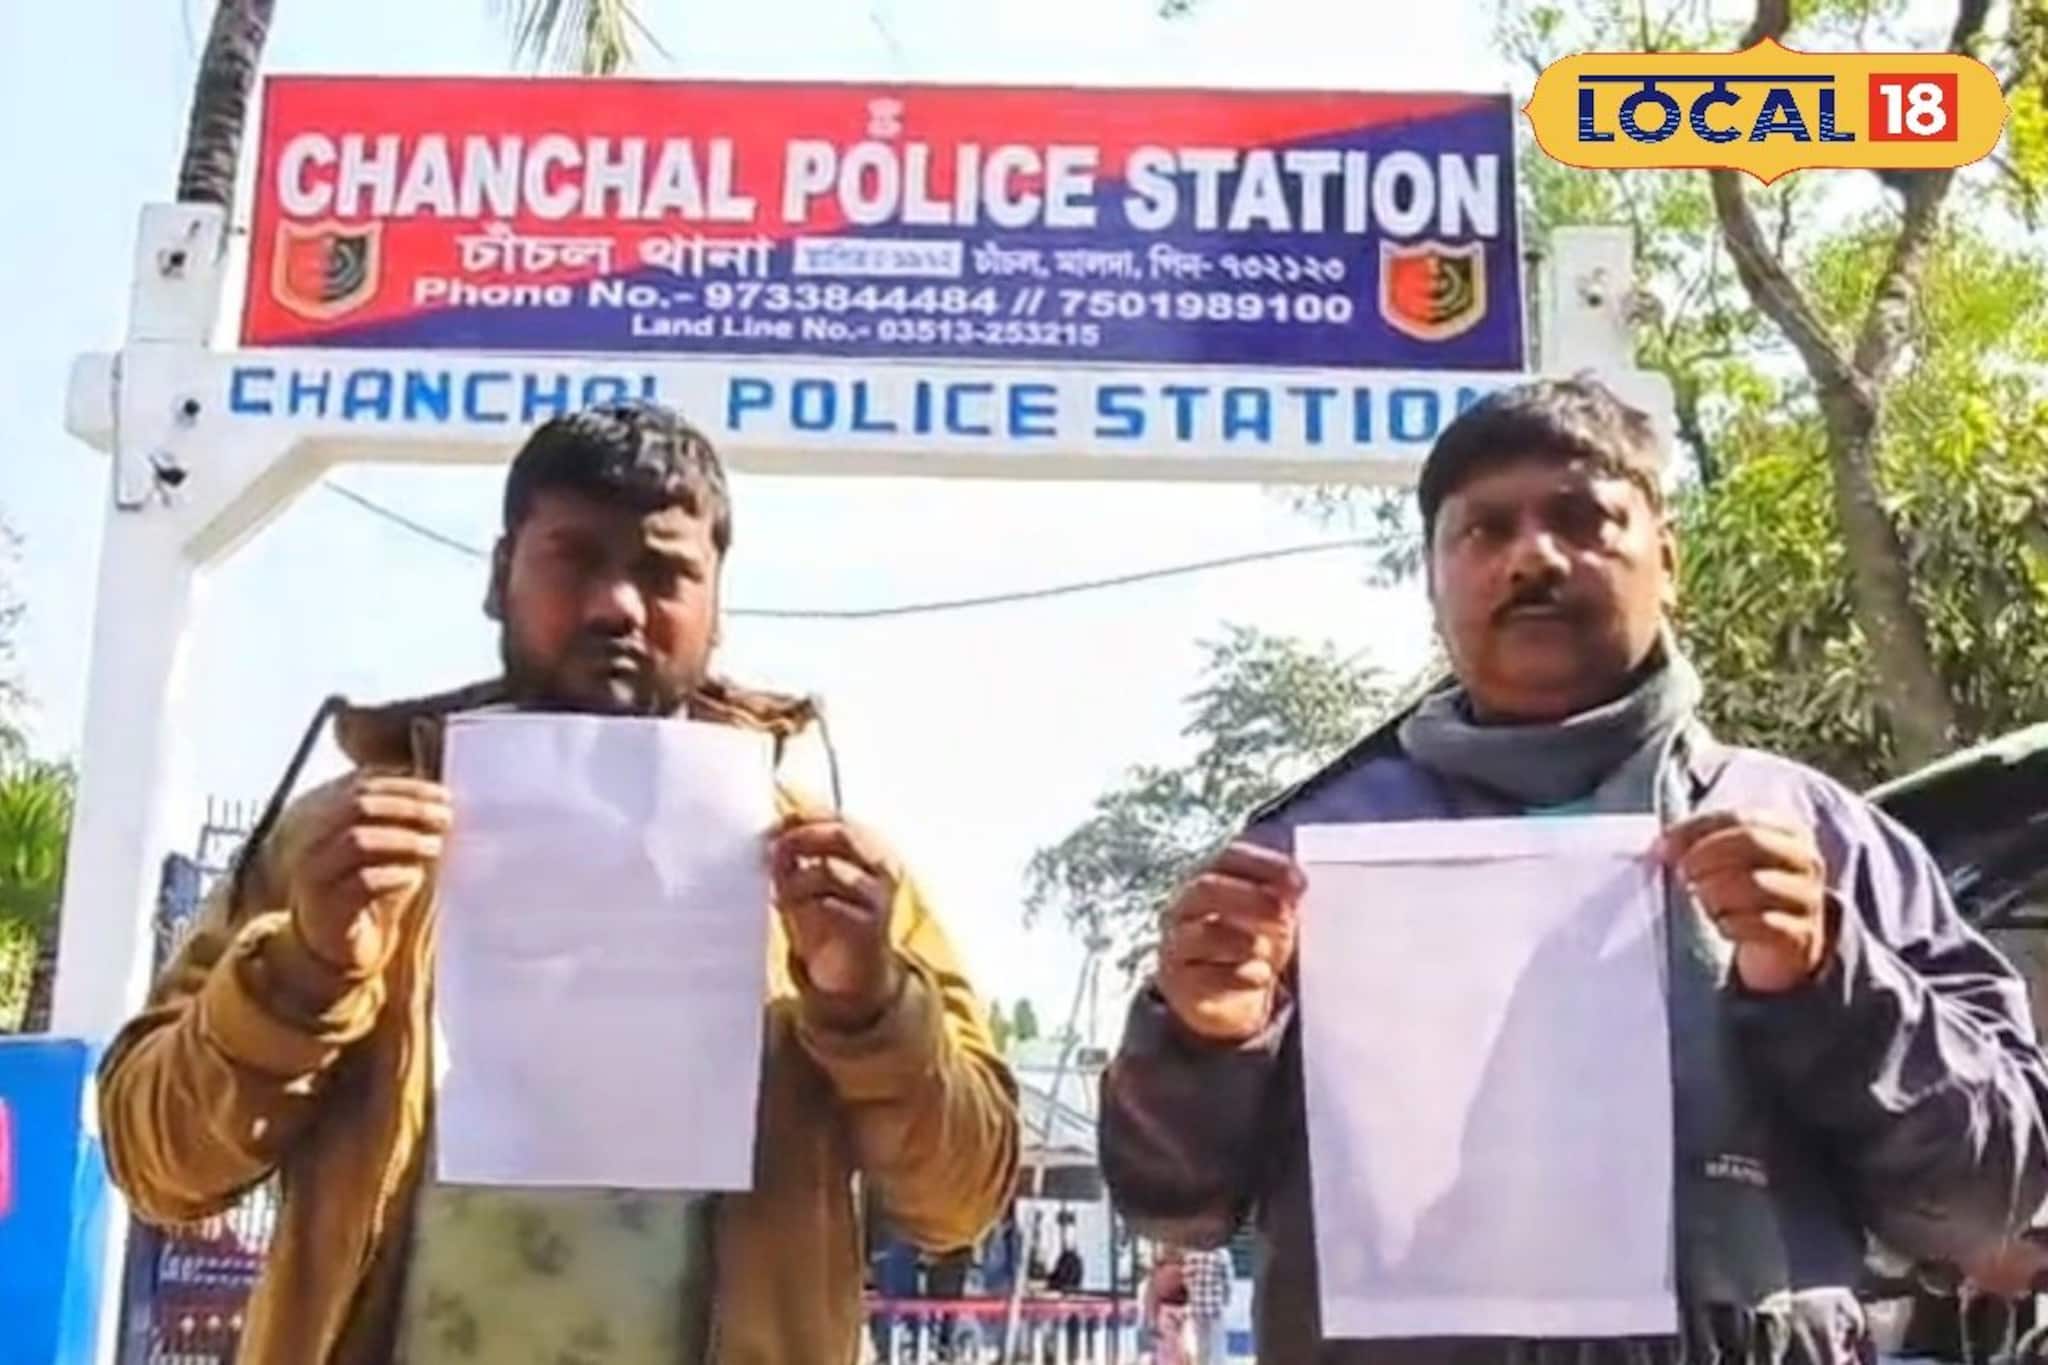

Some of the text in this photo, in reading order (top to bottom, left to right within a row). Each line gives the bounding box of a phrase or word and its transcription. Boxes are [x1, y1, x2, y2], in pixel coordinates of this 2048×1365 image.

[278, 133, 1498, 237] CHANCHAL POLICE STATION
[455, 222, 616, 275] চাঁচল
[638, 234, 775, 278] থানা
[414, 277, 573, 307] Phone
[704, 281, 999, 315] 9733844484
[1058, 289, 1353, 324] 7501989100
[632, 313, 714, 337] Land
[722, 315, 793, 339] Line
[877, 318, 1100, 347] 03513-253215
[726, 377, 1058, 438] POLICE
[1094, 385, 1482, 443] STATIO
